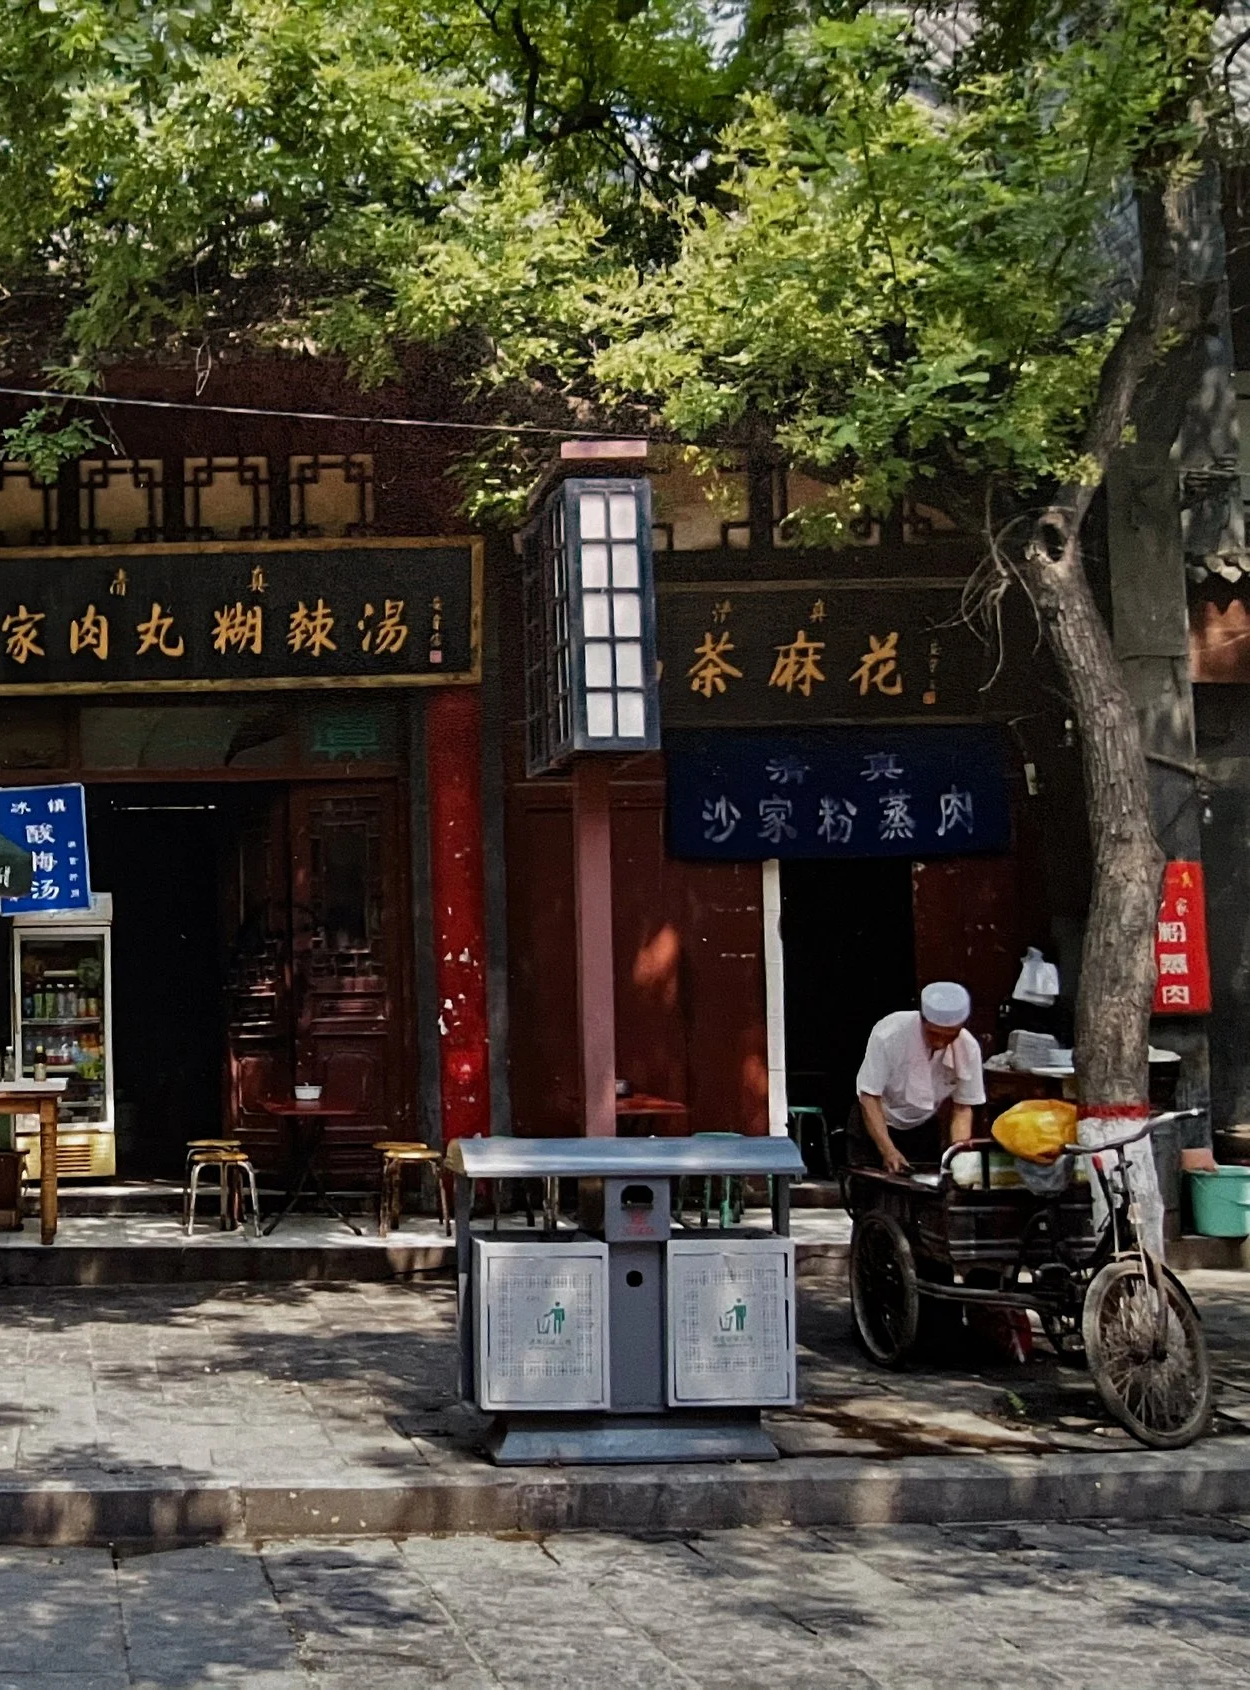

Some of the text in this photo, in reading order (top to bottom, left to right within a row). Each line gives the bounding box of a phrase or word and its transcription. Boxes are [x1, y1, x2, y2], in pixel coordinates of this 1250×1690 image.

[656, 630, 903, 698] 茶麻花
[701, 784, 974, 844] 沙家粉蒸肉
